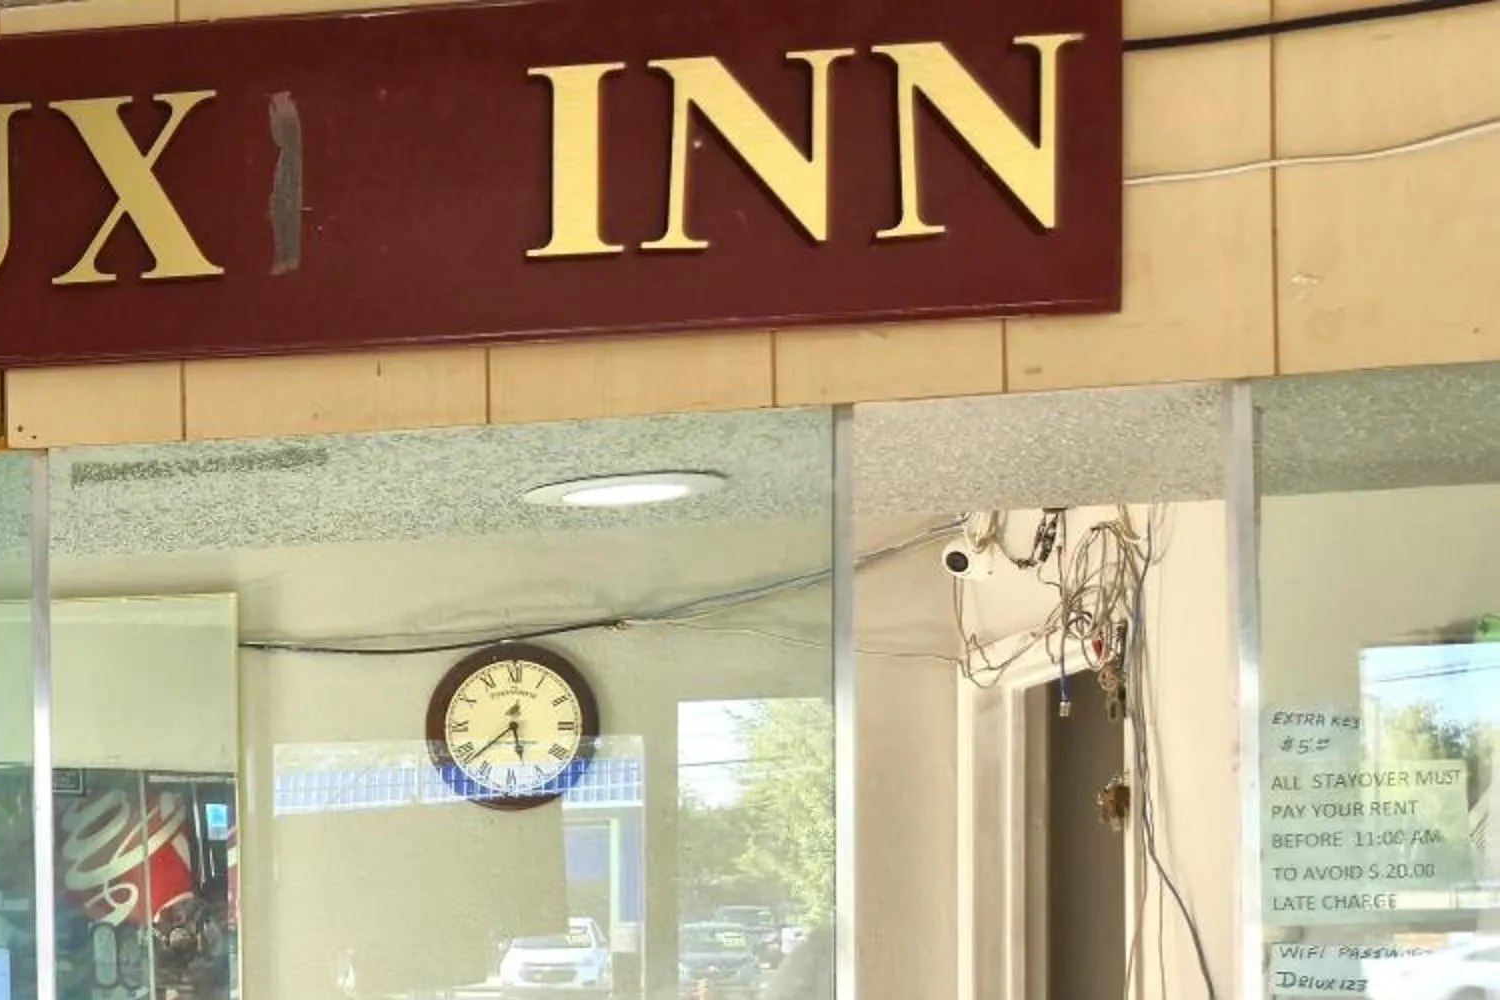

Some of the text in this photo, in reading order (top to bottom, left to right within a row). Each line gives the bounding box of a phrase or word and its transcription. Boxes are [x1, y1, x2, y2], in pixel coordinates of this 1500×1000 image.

[526, 31, 1084, 260] INN
[1272, 711, 1325, 727] EXTRA
[1271, 769, 1461, 791] ALL STAYOVER MUST
[1271, 800, 1419, 819] PAY YOUR RENT
[1271, 831, 1343, 849] BEFORE
[1271, 866, 1298, 882] TO
[1303, 865, 1363, 881] AVOID
[1272, 893, 1397, 911] LATE CHARGE
